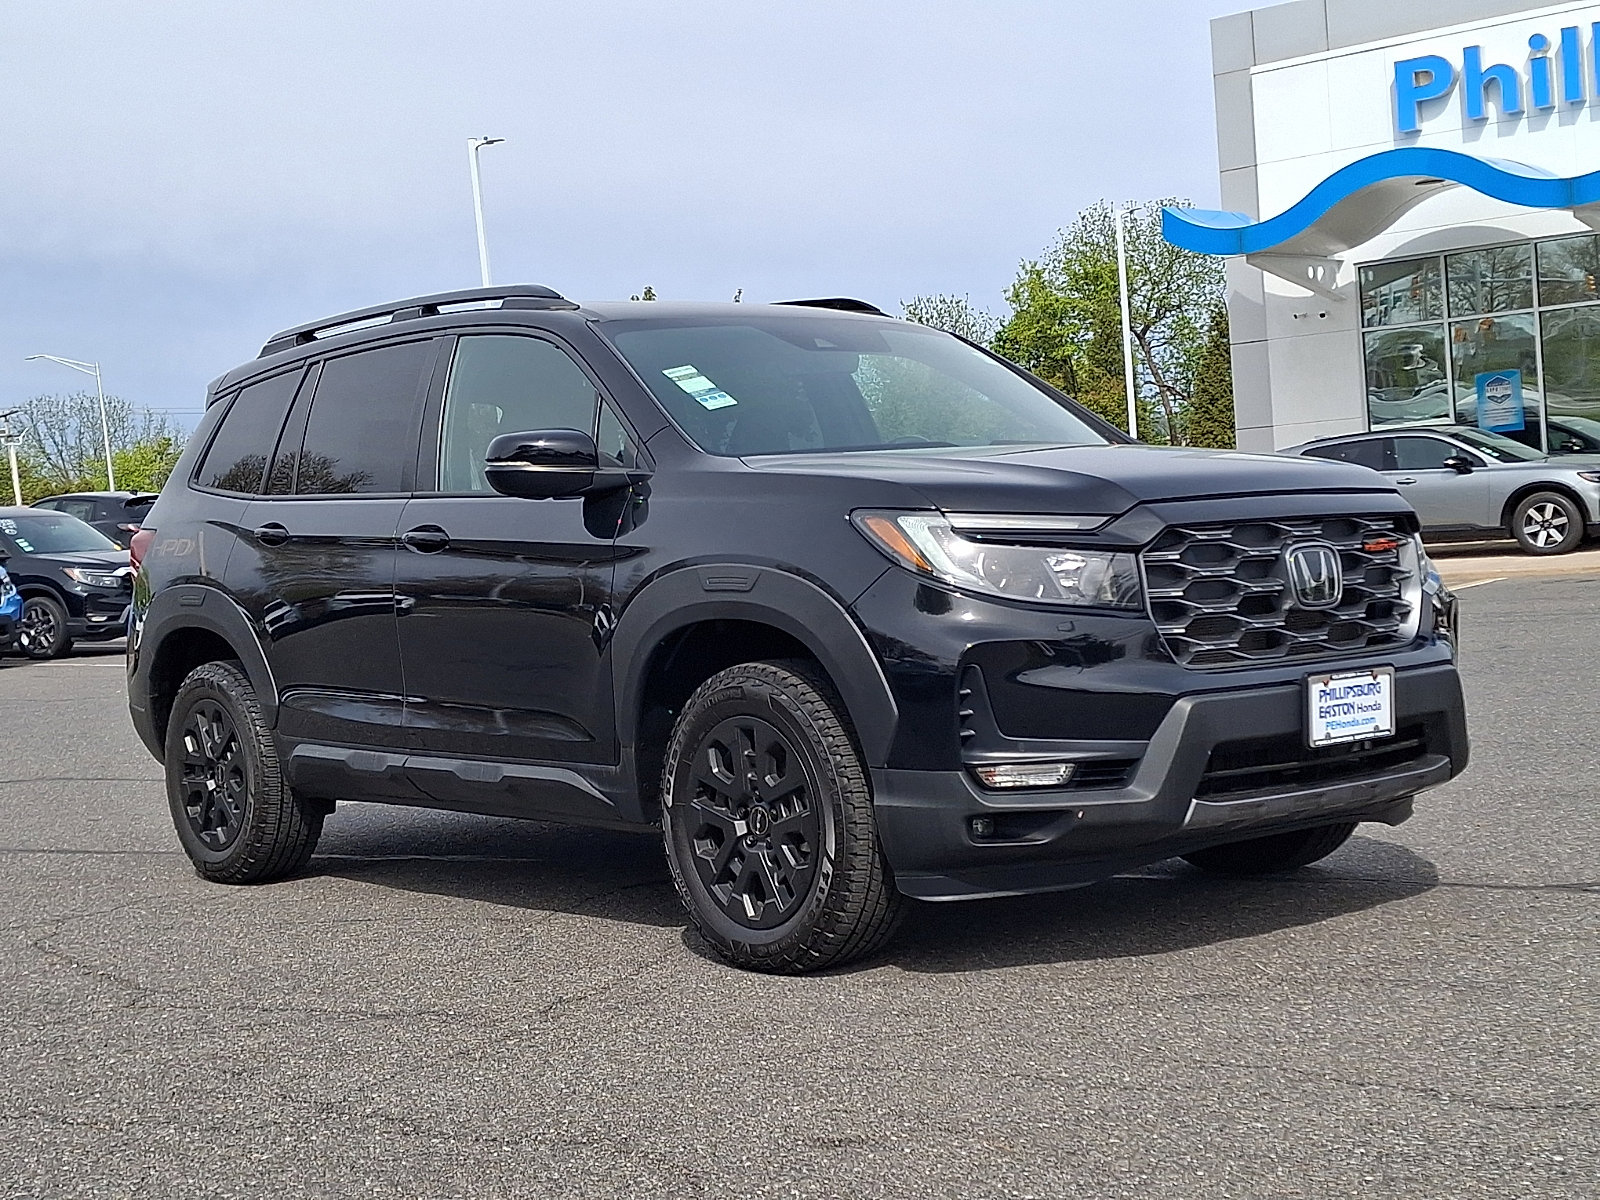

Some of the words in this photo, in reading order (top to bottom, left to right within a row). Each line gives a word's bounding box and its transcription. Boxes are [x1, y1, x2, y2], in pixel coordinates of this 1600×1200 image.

[1319, 682, 1382, 703] PHILLIPSBURG
[1319, 702, 1356, 719] EASTON
[1357, 700, 1382, 714] Honda
